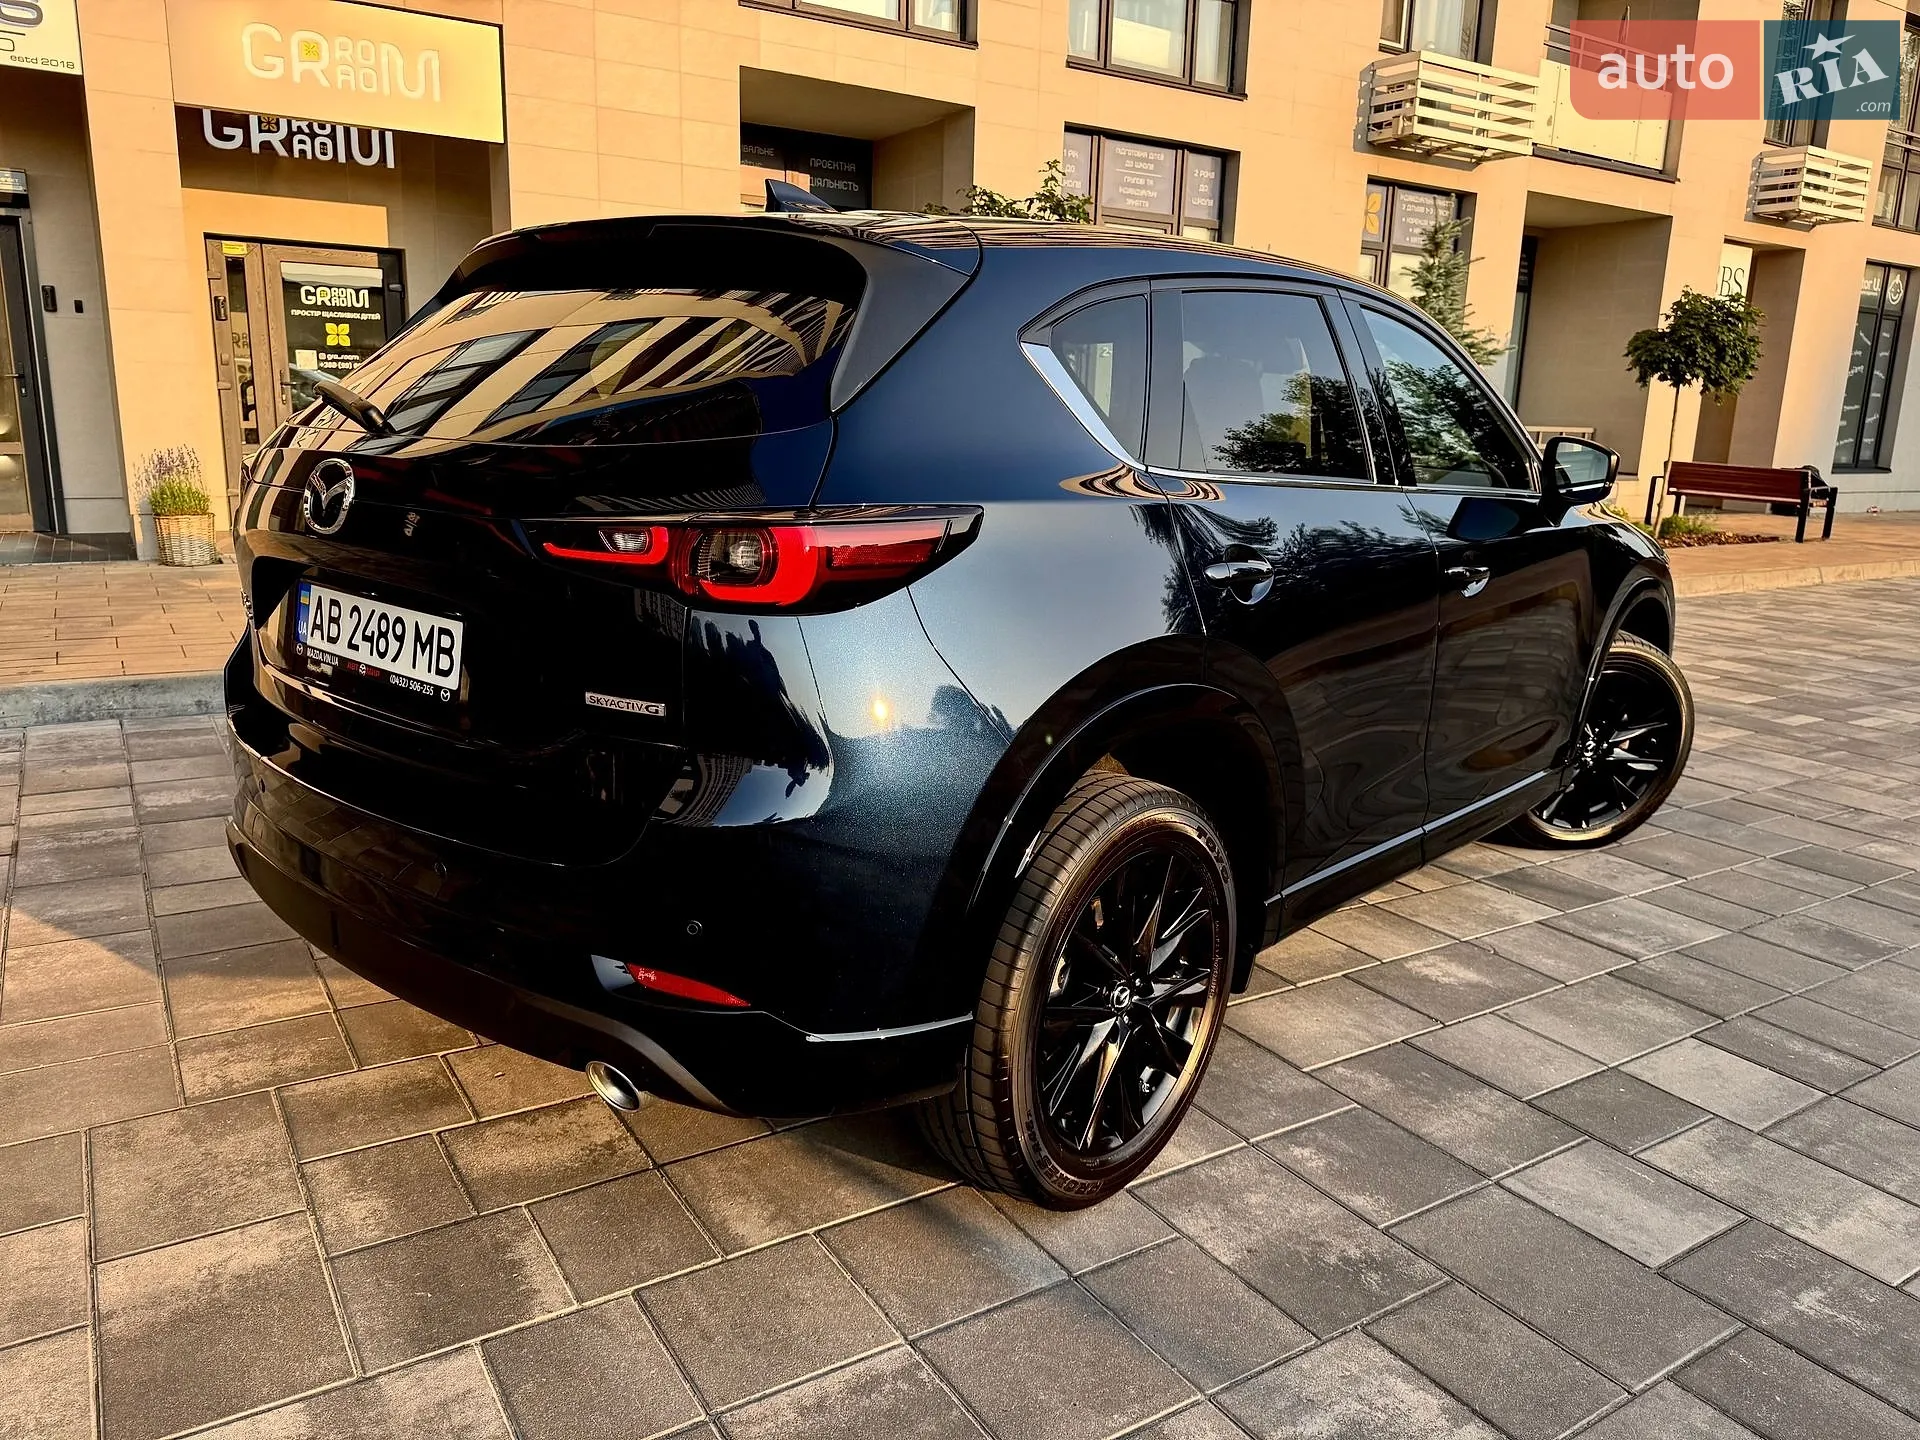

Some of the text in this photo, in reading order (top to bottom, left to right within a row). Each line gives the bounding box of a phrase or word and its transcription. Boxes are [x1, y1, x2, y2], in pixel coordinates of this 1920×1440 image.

[10, 55, 75, 70] estd 2018
[742, 144, 775, 157] ВАЛЬНЕ
[1715, 264, 1745, 298] BS
[290, 309, 321, 318] ПРОСТІР
[297, 620, 307, 636] UA
[310, 594, 342, 645] AB
[346, 604, 407, 664] 2489
[411, 620, 455, 678] MB
[389, 674, 434, 696] (0432) 506-255
